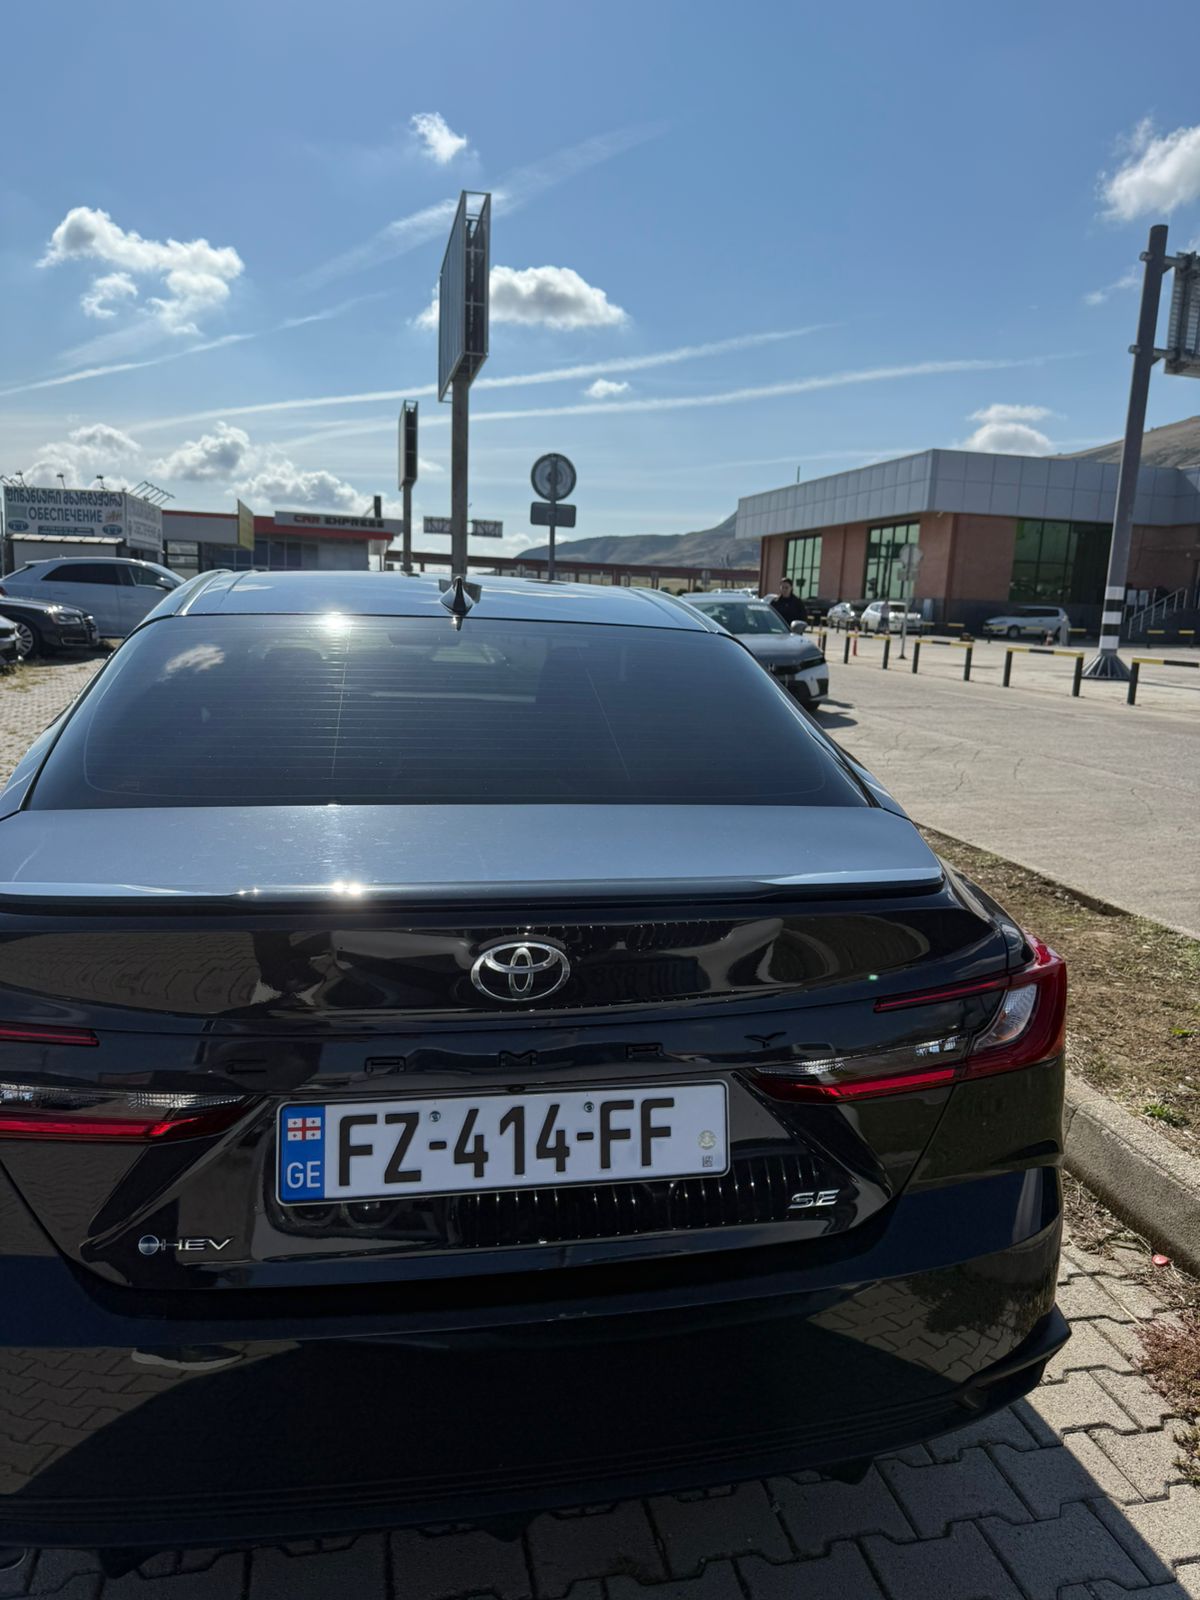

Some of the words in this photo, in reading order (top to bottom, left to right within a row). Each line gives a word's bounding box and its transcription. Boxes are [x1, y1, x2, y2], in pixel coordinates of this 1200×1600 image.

[28, 506, 103, 523] ОБЕСПЕЧЕНИЕ
[294, 515, 321, 524] CAR
[324, 517, 384, 528] EXPRESS
[338, 1097, 675, 1188] FZ-414-FF
[286, 1160, 322, 1190] GE
[787, 1188, 840, 1209] SE
